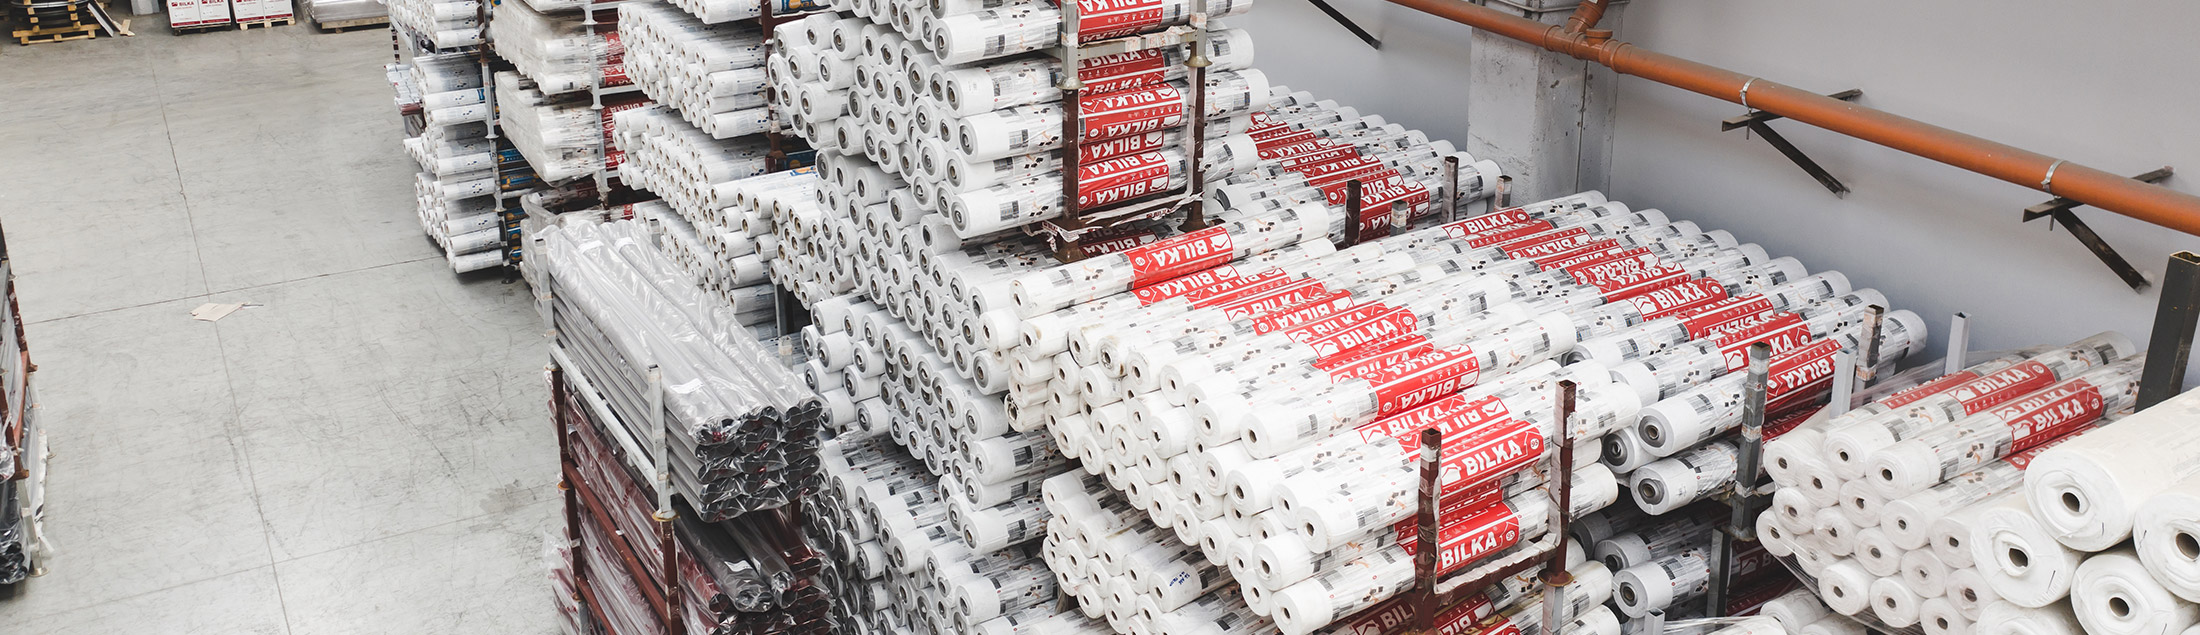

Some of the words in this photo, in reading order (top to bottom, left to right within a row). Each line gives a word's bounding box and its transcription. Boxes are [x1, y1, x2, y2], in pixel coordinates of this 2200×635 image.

[1100, 91, 1156, 108] BILKA
[1107, 118, 1159, 137] BILKA
[1091, 135, 1141, 158] BILKA
[1273, 142, 1315, 157] BILKA
[1087, 157, 1142, 174] BILKA
[1319, 158, 1361, 173] BILKA
[1095, 181, 1146, 204] BILKA
[1361, 186, 1406, 205] BILKA
[1466, 213, 1514, 235] BILKA
[1083, 238, 1136, 254] BILKA
[1151, 239, 1209, 267] BILKA
[1155, 271, 1219, 297] BILKA
[1648, 282, 1708, 309] BILKA
[1273, 305, 1331, 328] BILKA
[1342, 319, 1399, 349] BILKA
[1780, 359, 1832, 389] BILKA
[1973, 368, 2031, 395] BILKA
[1401, 379, 1456, 409] BILKA
[2033, 398, 2085, 432] BILKA
[1462, 439, 1523, 476] BILKA
[1531, 439, 1539, 448] 95
[1440, 531, 1498, 569] BILKA
[1506, 532, 1515, 540] 95
[1380, 604, 1413, 630] BIL
